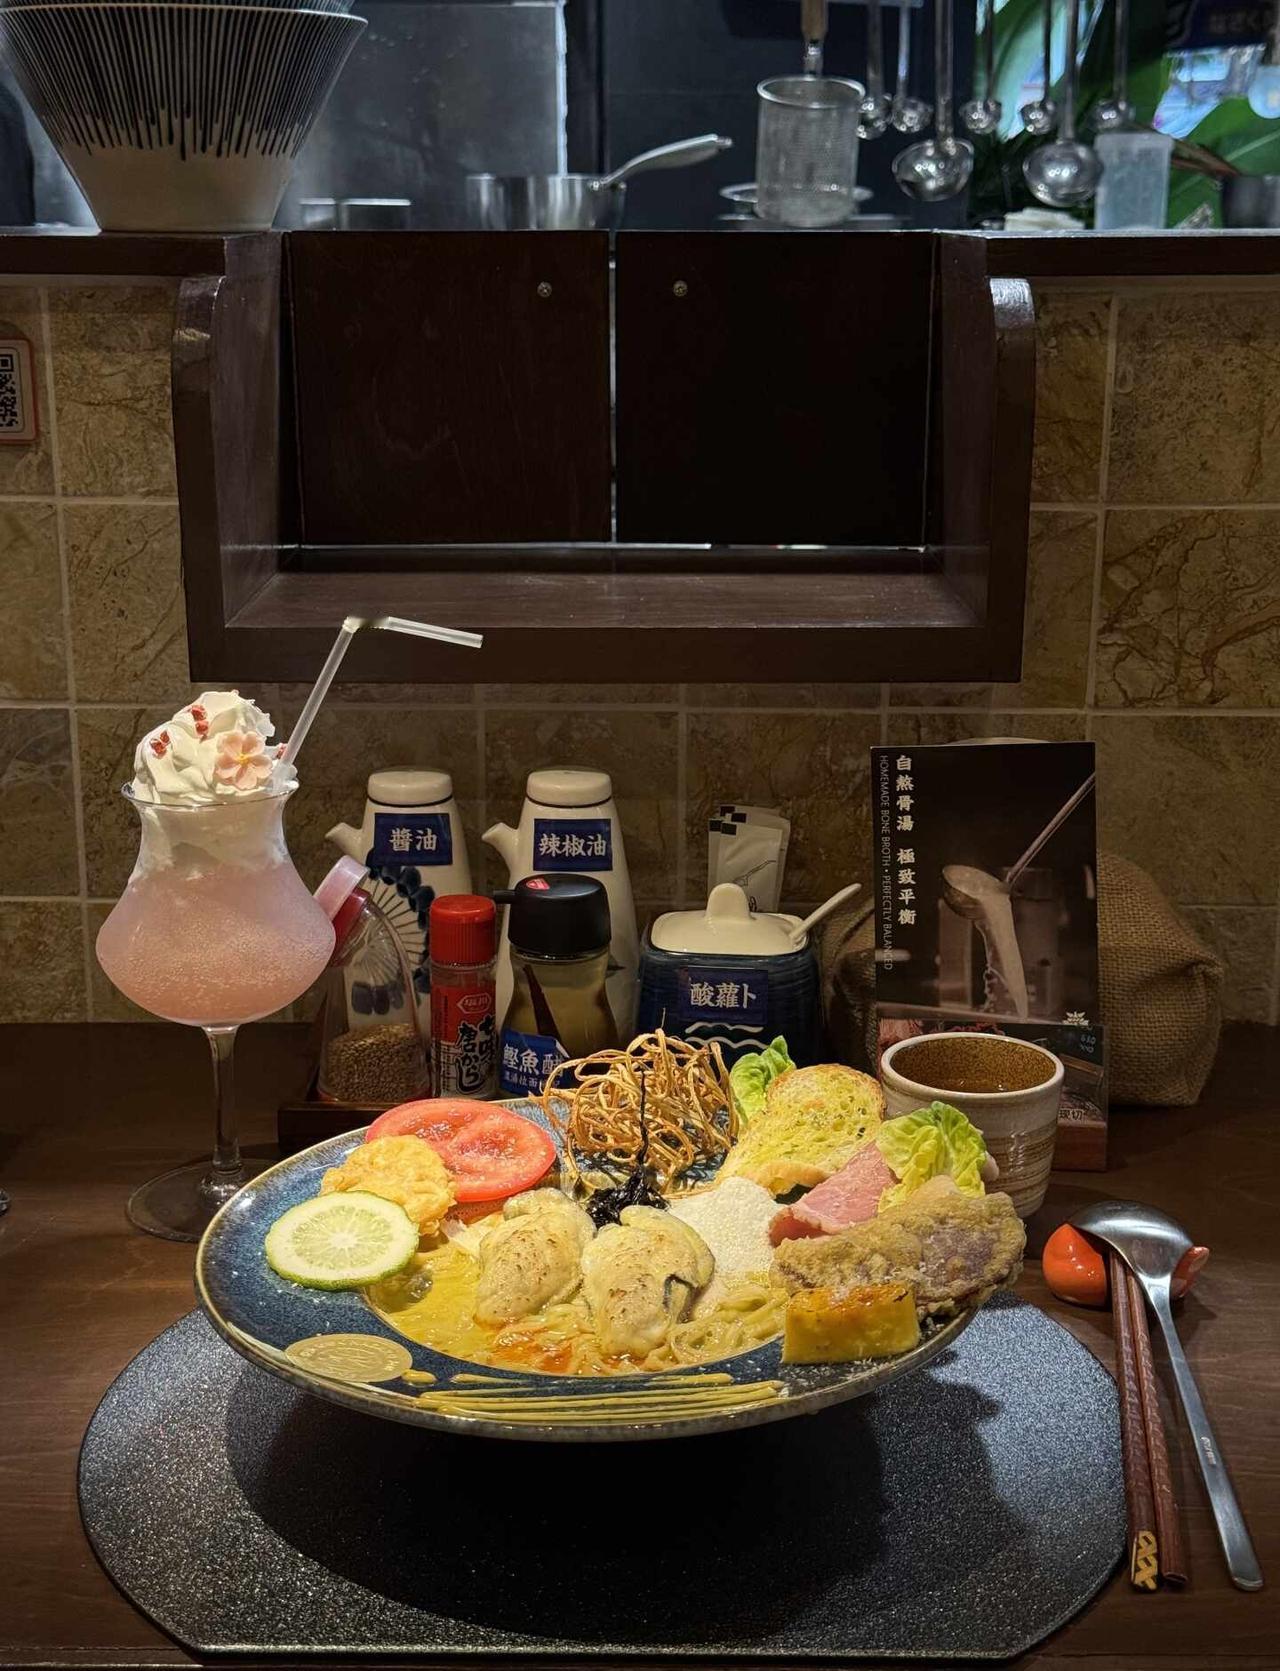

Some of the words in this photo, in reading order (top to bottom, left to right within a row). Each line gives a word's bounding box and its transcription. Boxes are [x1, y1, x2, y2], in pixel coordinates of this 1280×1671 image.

[880, 755, 890, 807] HOMEMADE
[896, 754, 915, 831] 自熬骨湯
[389, 827, 437, 851] 醬油
[881, 810, 891, 834] BONE
[539, 833, 607, 857] 辣椒油
[881, 837, 892, 866] BROTH
[882, 875, 892, 921] PERFECTLY
[897, 848, 917, 925] 極致平衡
[883, 924, 893, 970] BALANCED
[690, 981, 757, 1009] 酸蘿卜
